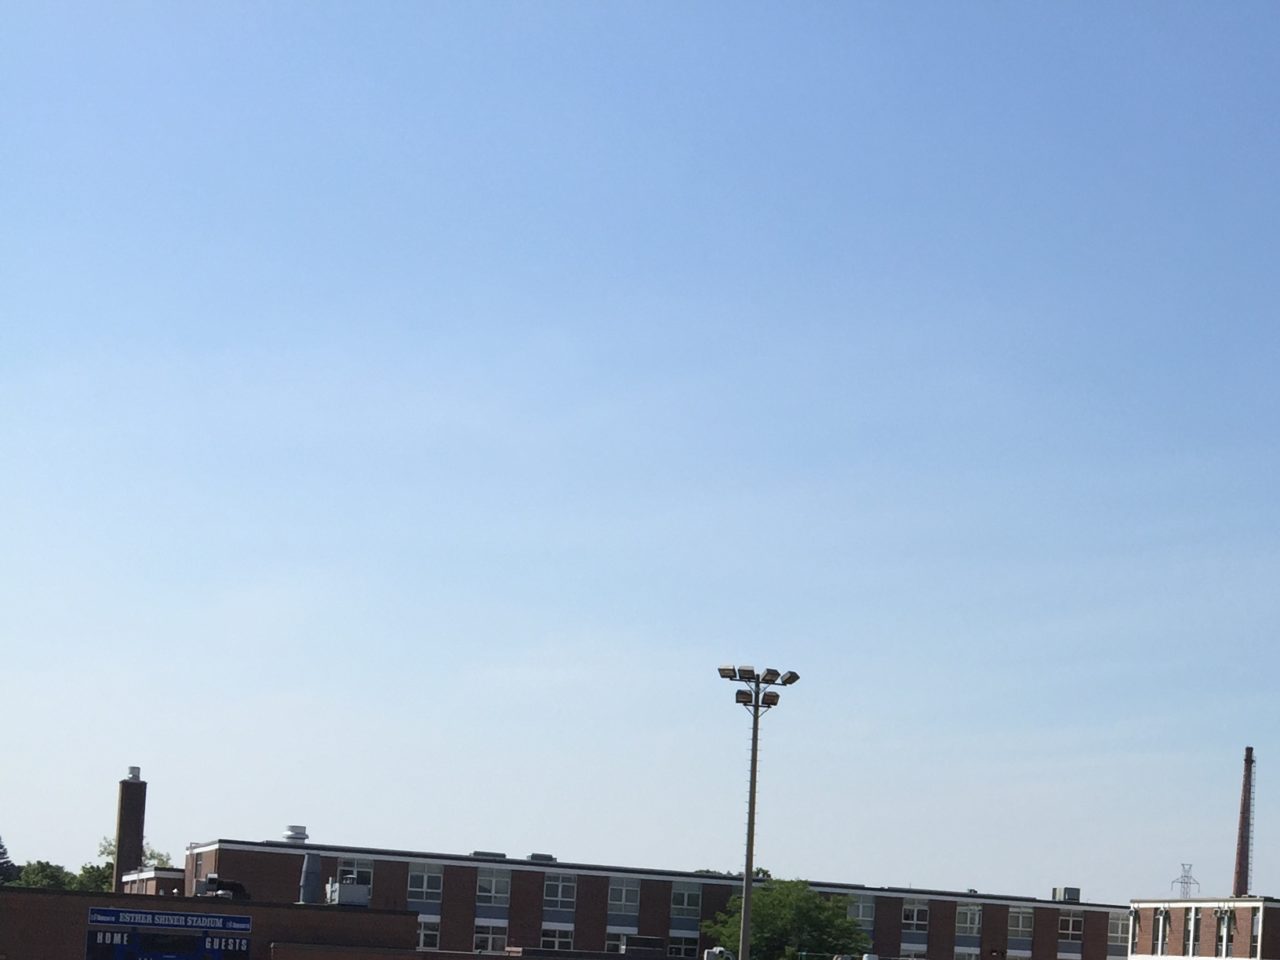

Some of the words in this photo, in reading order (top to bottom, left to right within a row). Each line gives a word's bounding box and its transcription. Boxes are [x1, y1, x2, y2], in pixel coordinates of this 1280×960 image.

[119, 912, 153, 923] ESTHER
[154, 914, 185, 925] SHINER
[186, 916, 224, 928] STADIUM
[96, 931, 128, 945] HOME
[205, 937, 247, 951] GUESTS
